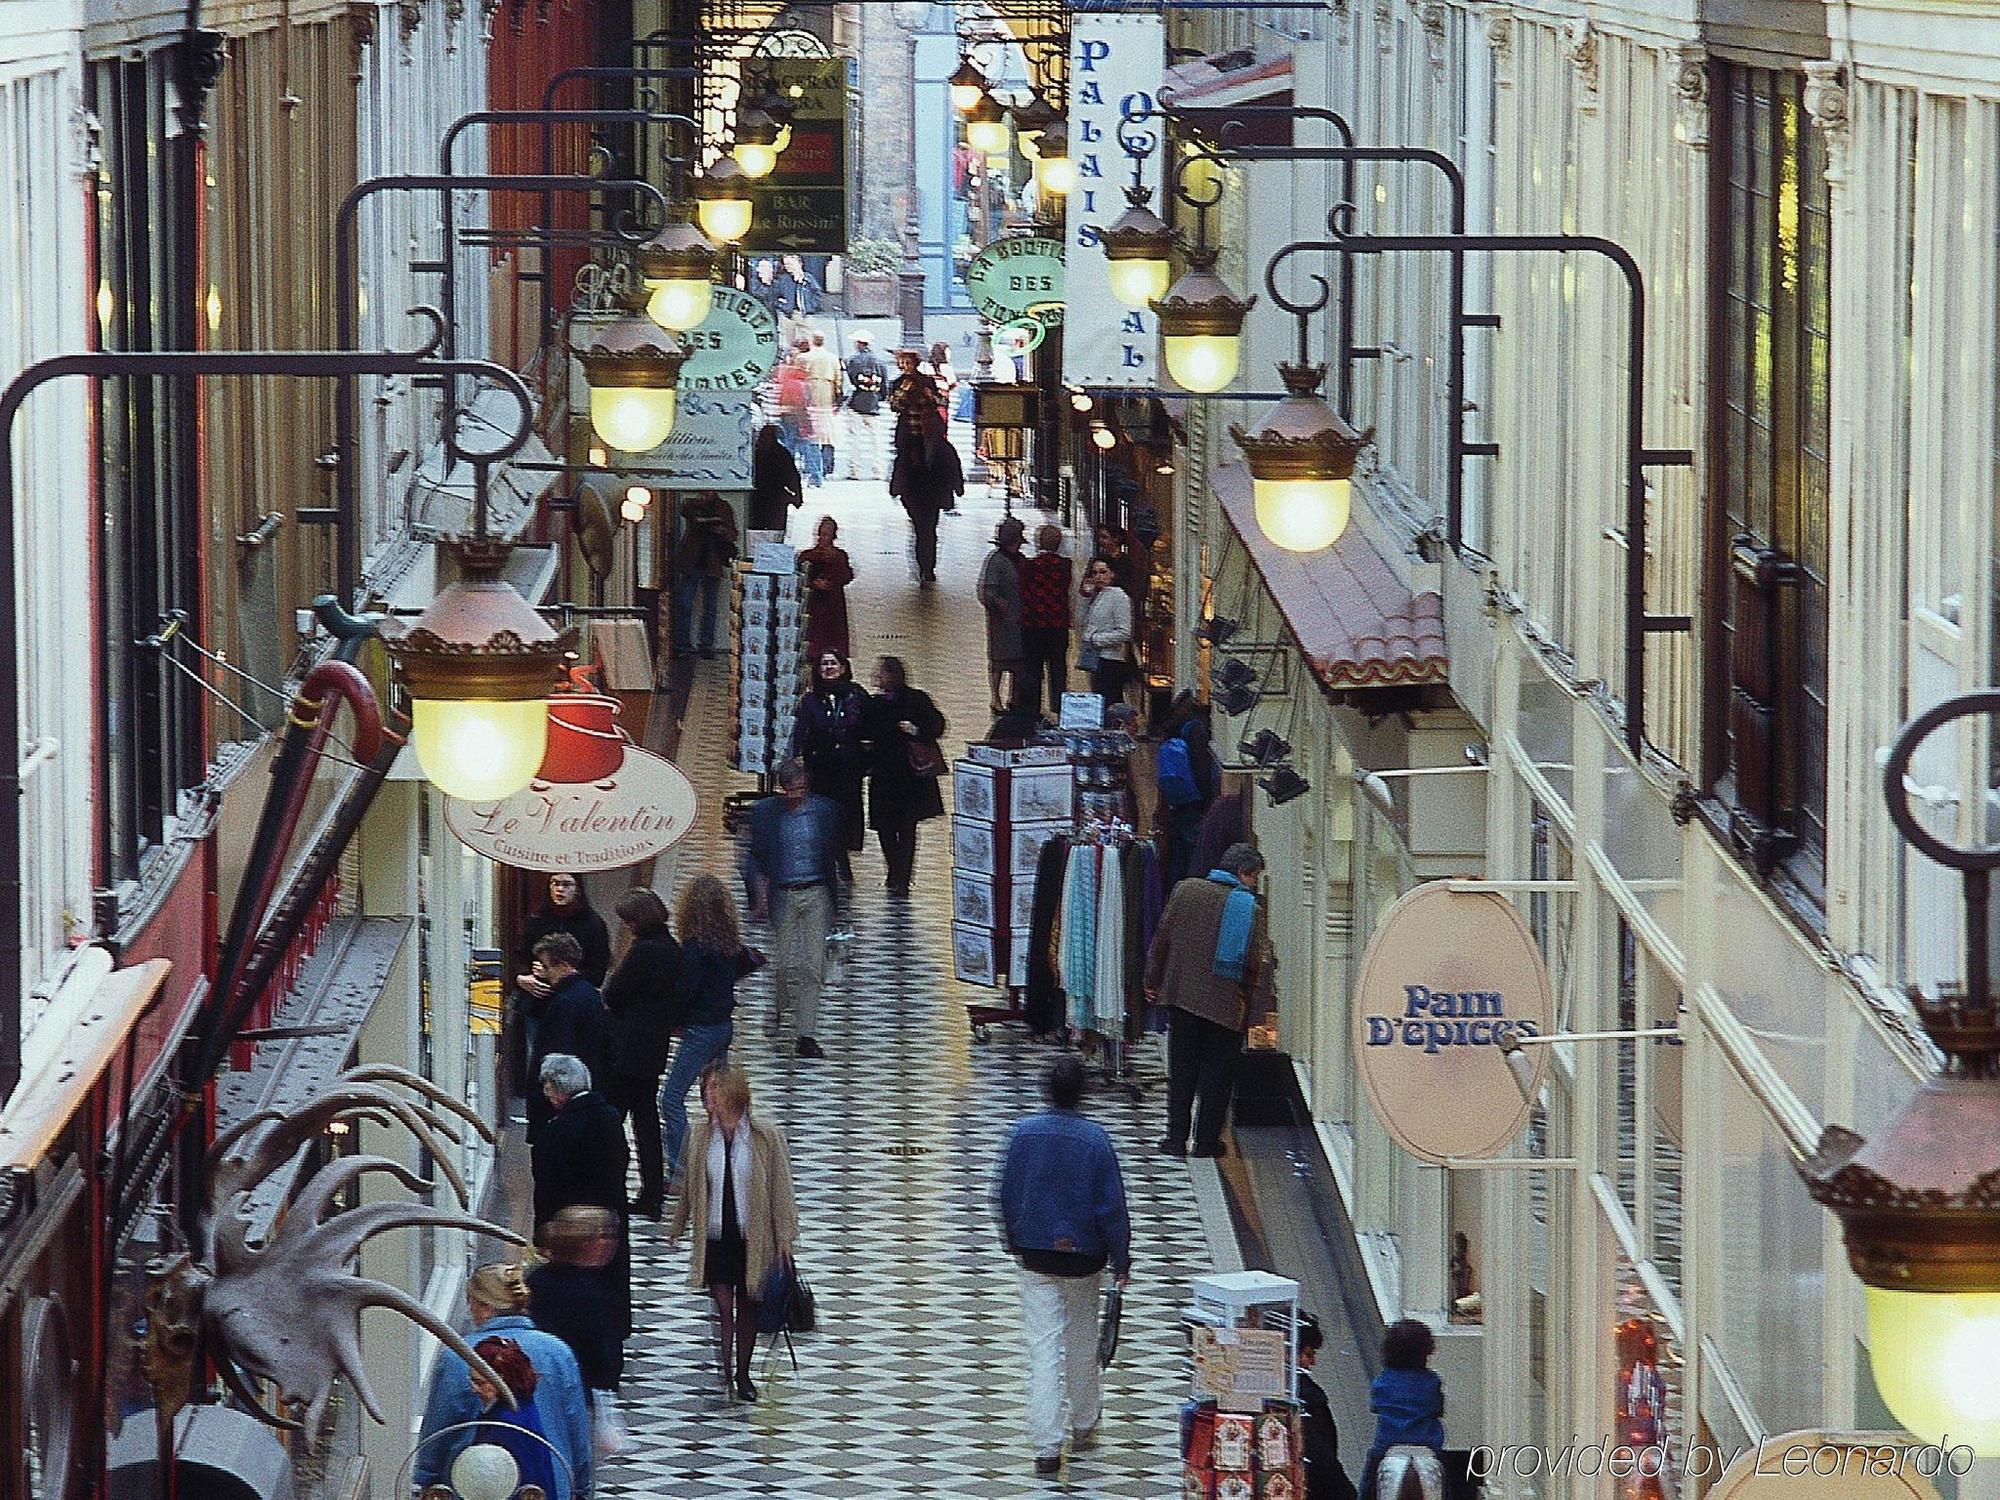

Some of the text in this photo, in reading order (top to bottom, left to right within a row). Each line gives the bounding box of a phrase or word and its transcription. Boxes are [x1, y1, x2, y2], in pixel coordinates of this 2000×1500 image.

[1074, 39, 1110, 247] PALAIS
[774, 195, 811, 210] BAR
[467, 796, 676, 835] Le Valentin
[494, 839, 655, 865] Cuisine et Traditions
[1404, 984, 1504, 1018] Pain
